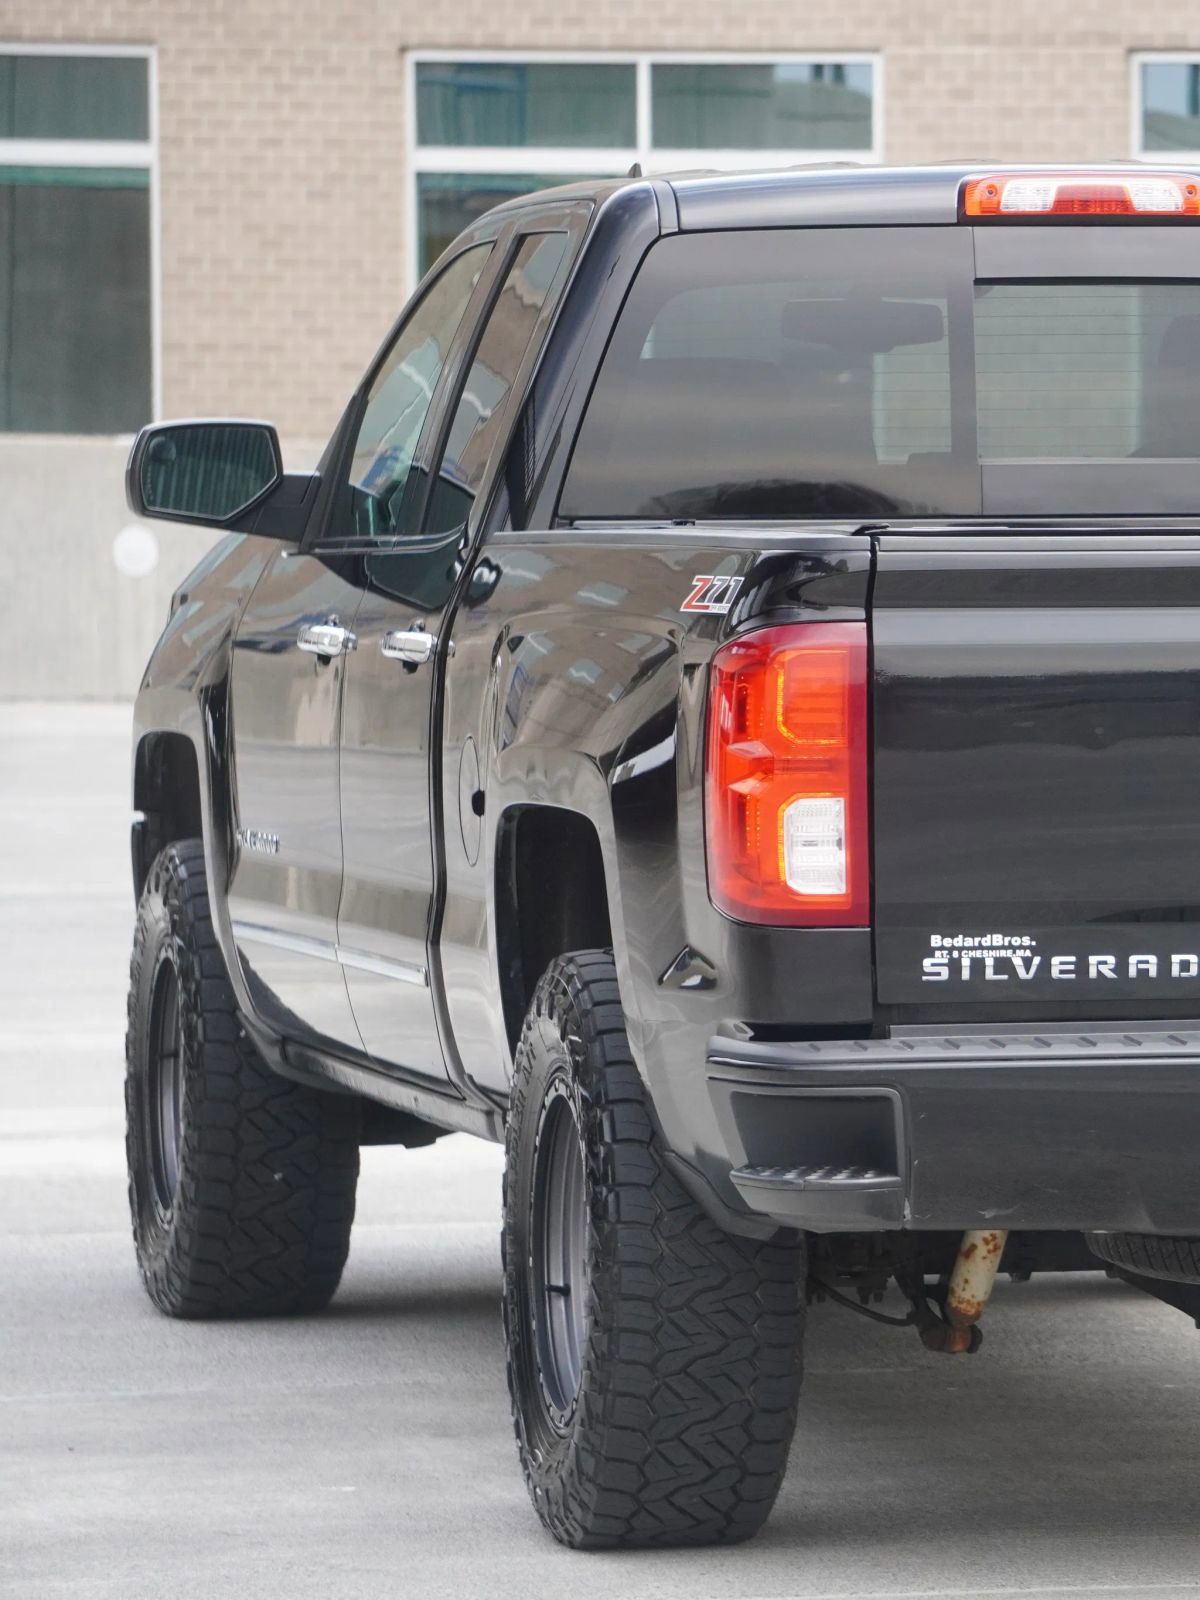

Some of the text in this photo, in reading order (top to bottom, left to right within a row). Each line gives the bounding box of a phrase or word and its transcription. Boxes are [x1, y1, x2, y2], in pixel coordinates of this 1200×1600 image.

[680, 575, 745, 613] Z71
[930, 934, 1036, 948] BedardBros.
[952, 950, 959, 958] 8
